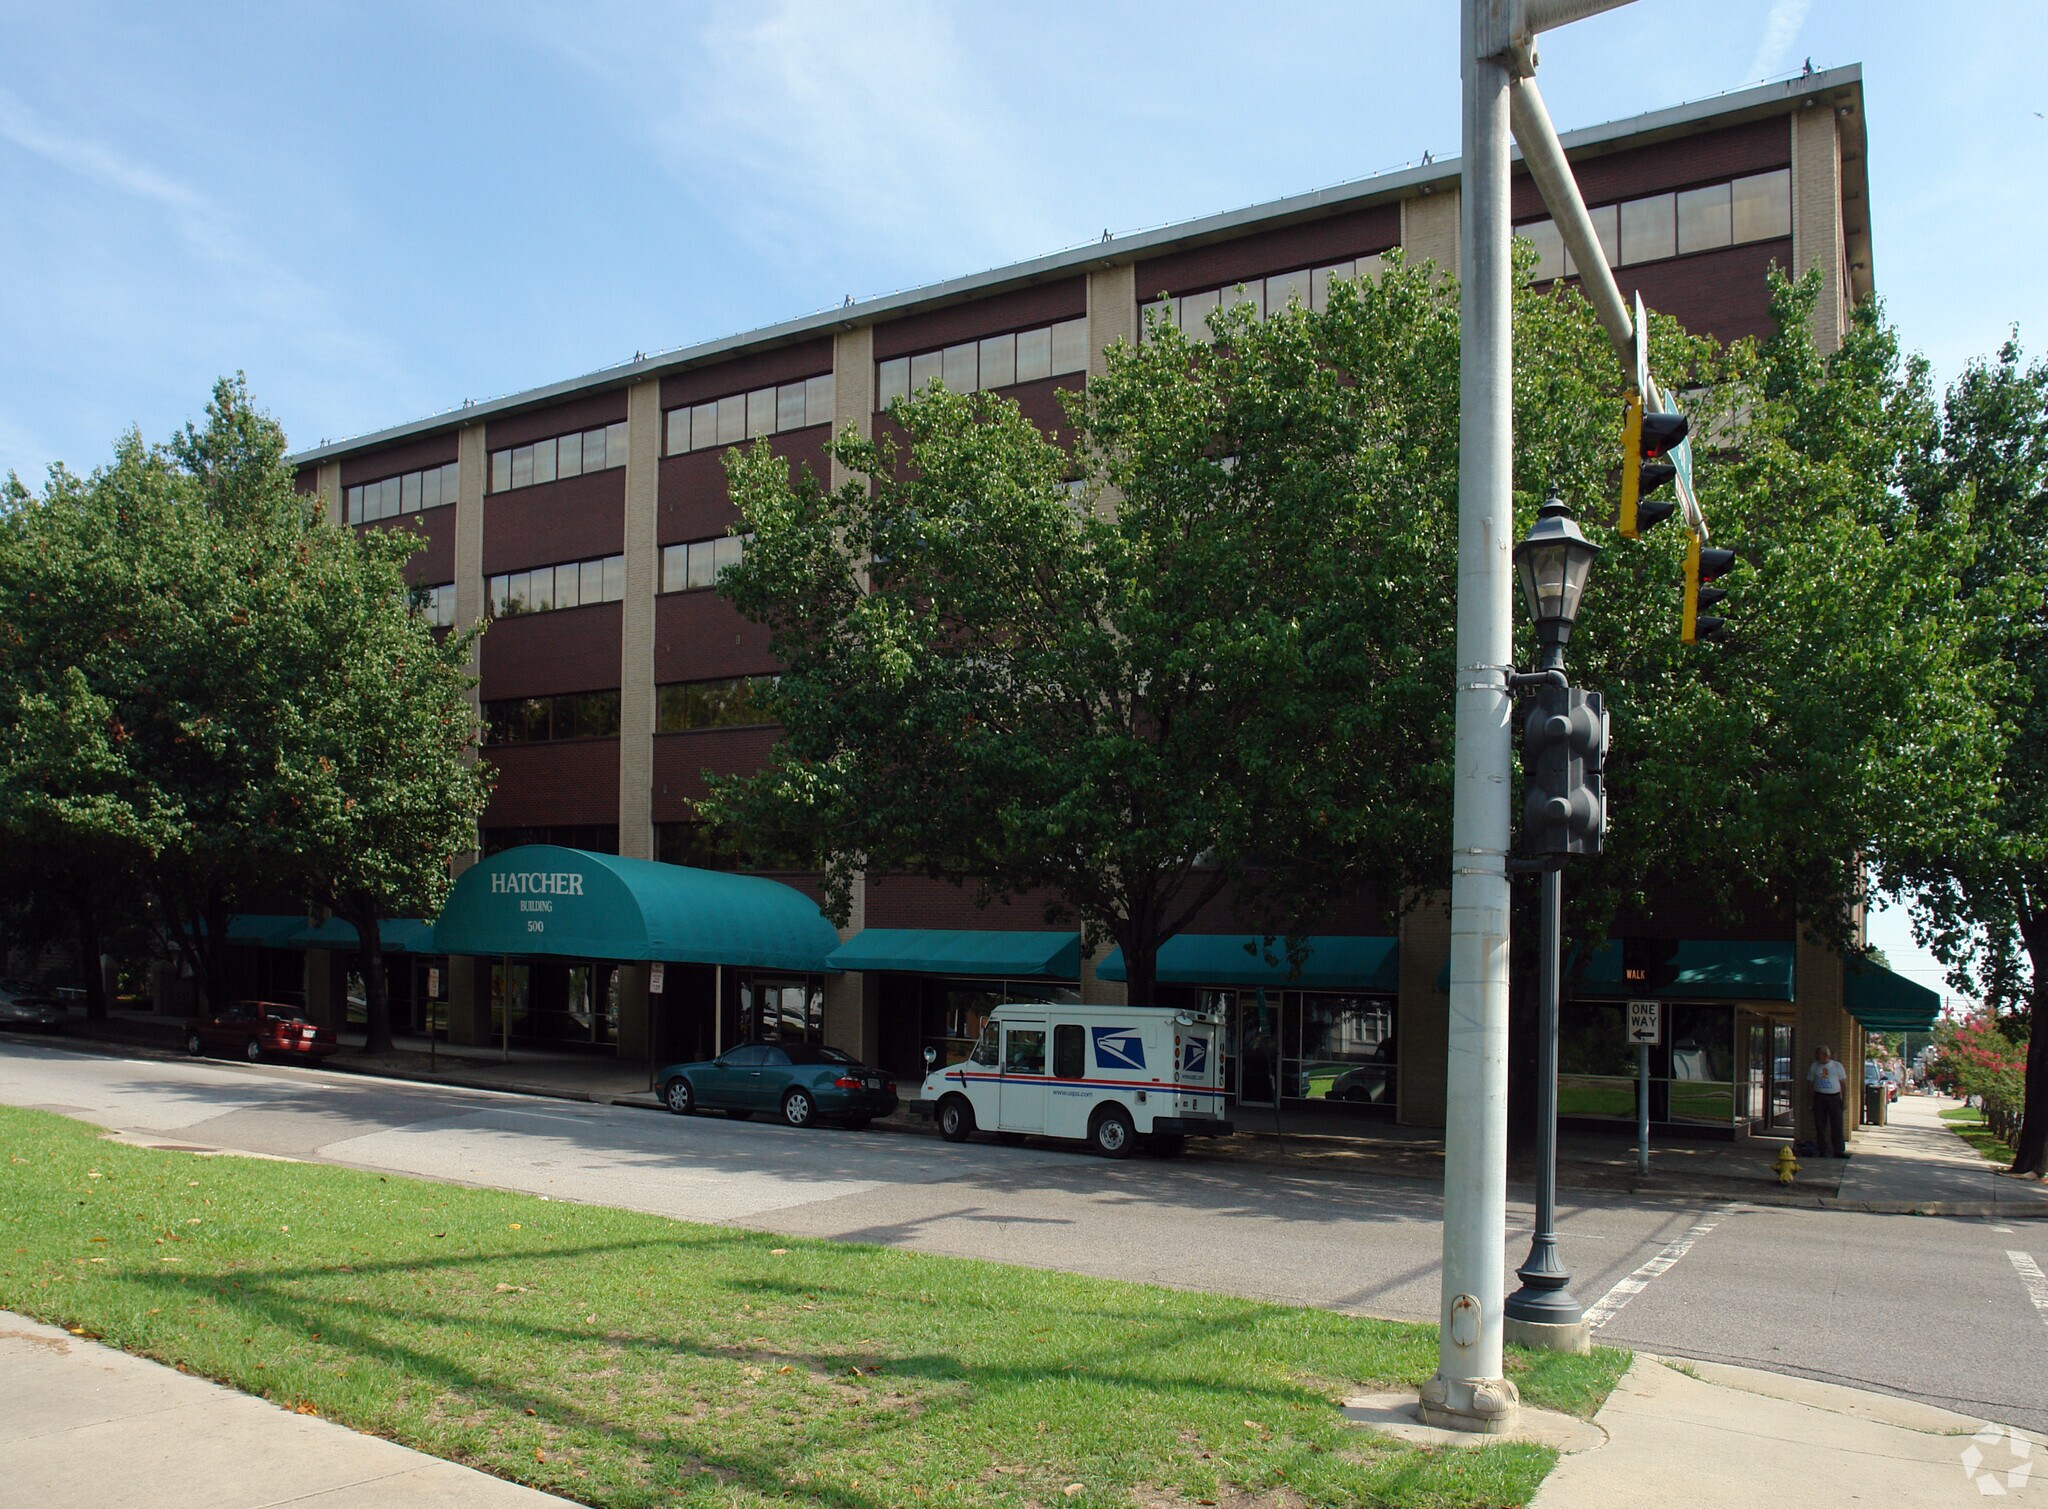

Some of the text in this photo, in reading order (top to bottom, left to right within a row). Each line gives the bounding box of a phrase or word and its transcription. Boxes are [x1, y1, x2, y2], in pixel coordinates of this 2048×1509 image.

[491, 872, 584, 895] HATCHER
[520, 900, 553, 912] BUILDING
[527, 920, 544, 932] 500
[1626, 969, 1645, 979] WALK
[1632, 1004, 1656, 1015] ONE
[1631, 1016, 1657, 1027] WAY
[1052, 1090, 1093, 1098] www.usps.com
